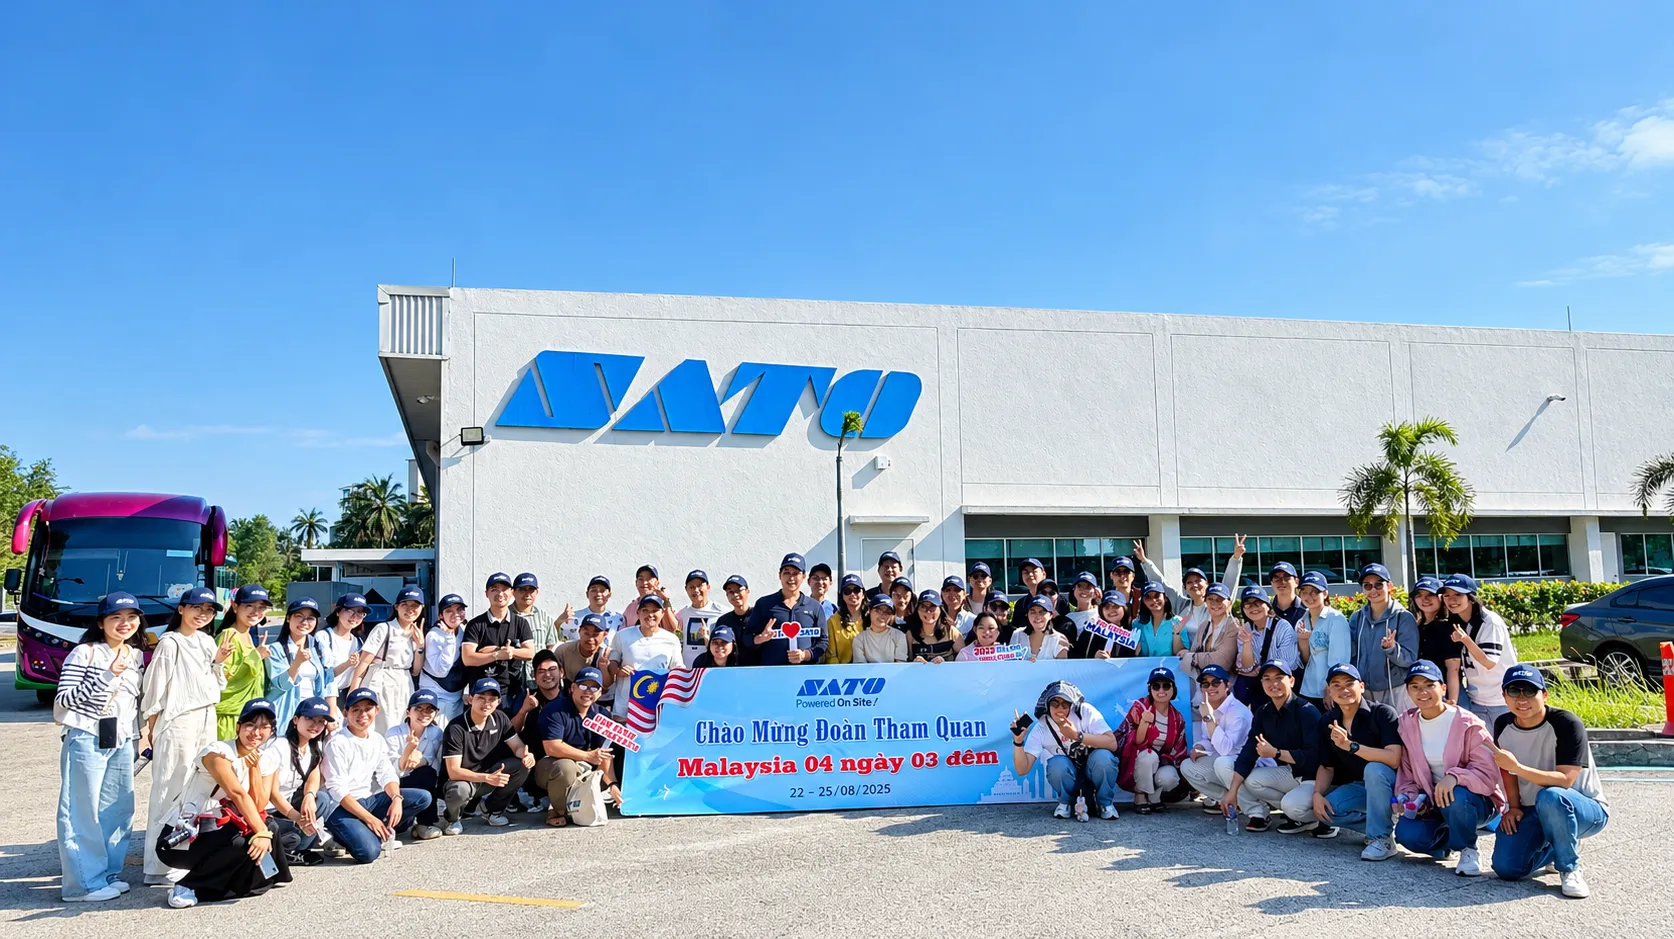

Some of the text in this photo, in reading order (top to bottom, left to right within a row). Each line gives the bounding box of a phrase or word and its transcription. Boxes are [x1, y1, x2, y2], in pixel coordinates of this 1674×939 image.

[495, 350, 922, 438] SATO
[1085, 621, 1136, 649] MALAYSIA
[796, 677, 887, 697] SATO
[796, 698, 835, 708] Powered
[837, 698, 851, 707] On
[695, 715, 987, 747] Chào Mừng Đoàn Tham Quan
[677, 749, 998, 780] Malaysia 04 ngày 03 đêm
[790, 787, 804, 798] 22
[818, 783, 891, 798] 25/08/2025
